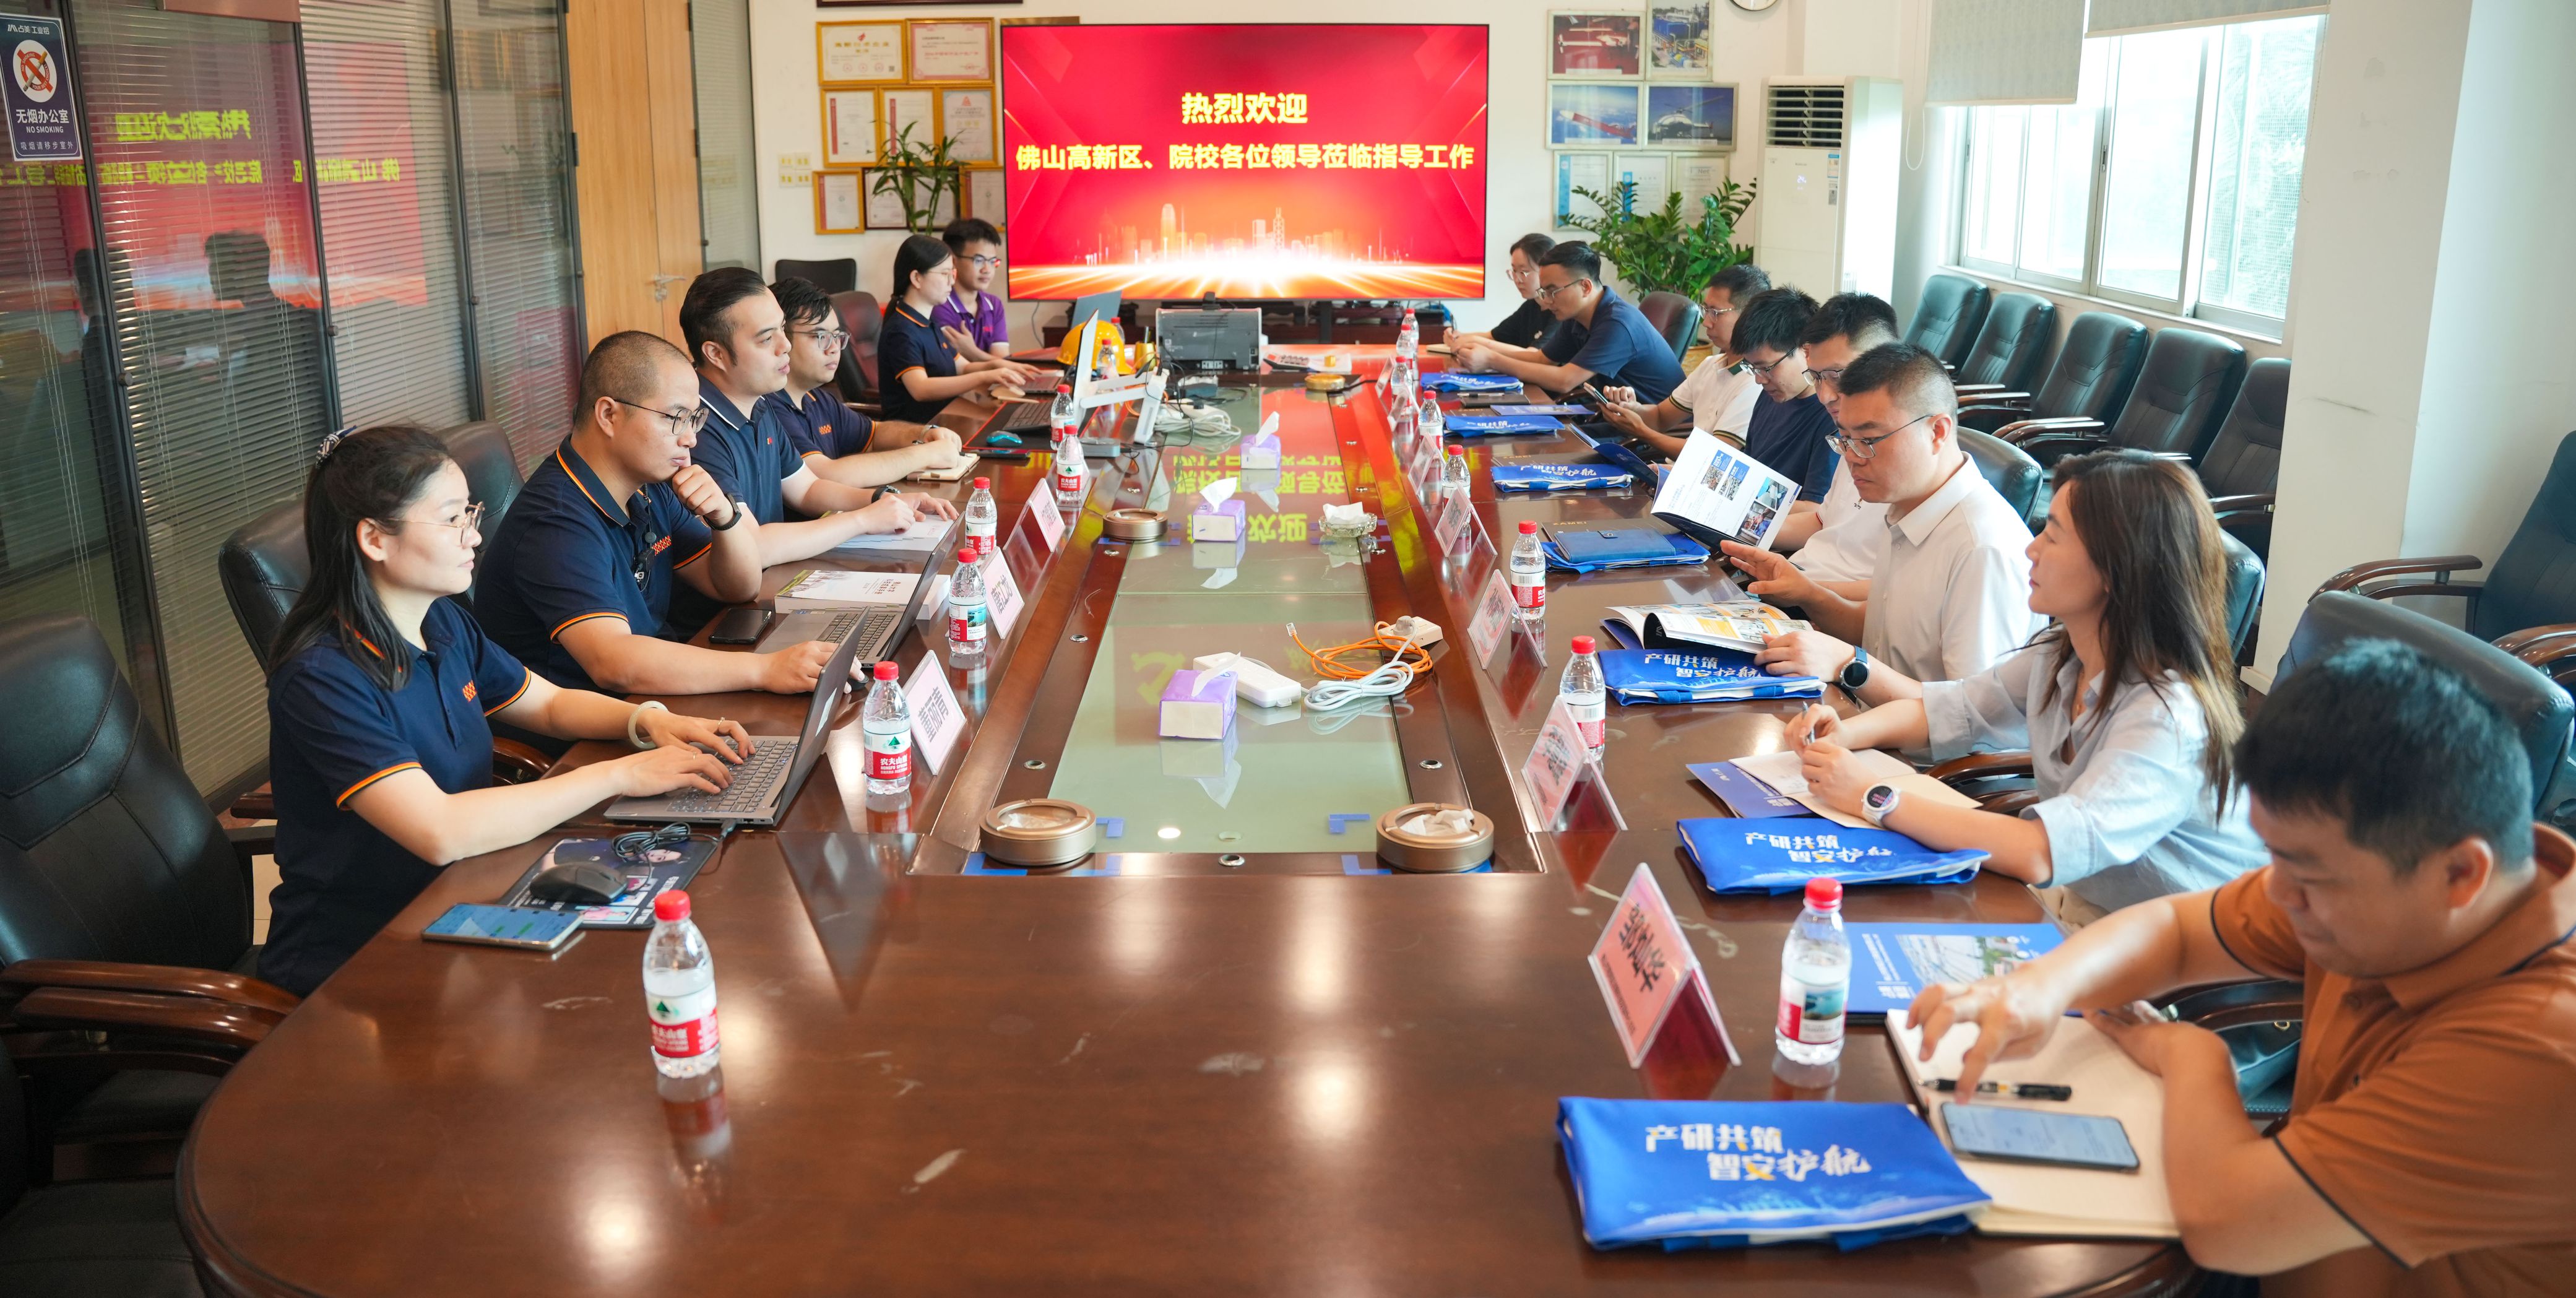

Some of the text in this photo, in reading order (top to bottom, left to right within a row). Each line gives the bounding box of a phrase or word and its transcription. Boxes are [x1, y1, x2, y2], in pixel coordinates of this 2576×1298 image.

[16, 109, 69, 123] 无烟办公室
[1182, 93, 1308, 124] 热烈欢迎
[20, 141, 74, 150] 吸烟请移步室外
[1016, 144, 1475, 170] 佛山高新区、院校各位领导莅临指导工作
[991, 574, 1013, 615] 唐江龙
[1644, 653, 1719, 669] 产研共筑
[1676, 666, 1762, 678] 智安护航
[918, 686, 949, 743] 董丽青
[1745, 832, 1839, 850] 产研共筑
[1645, 1123, 1786, 1154] 产研共筑
[1706, 1144, 1872, 1182] 智安护航
